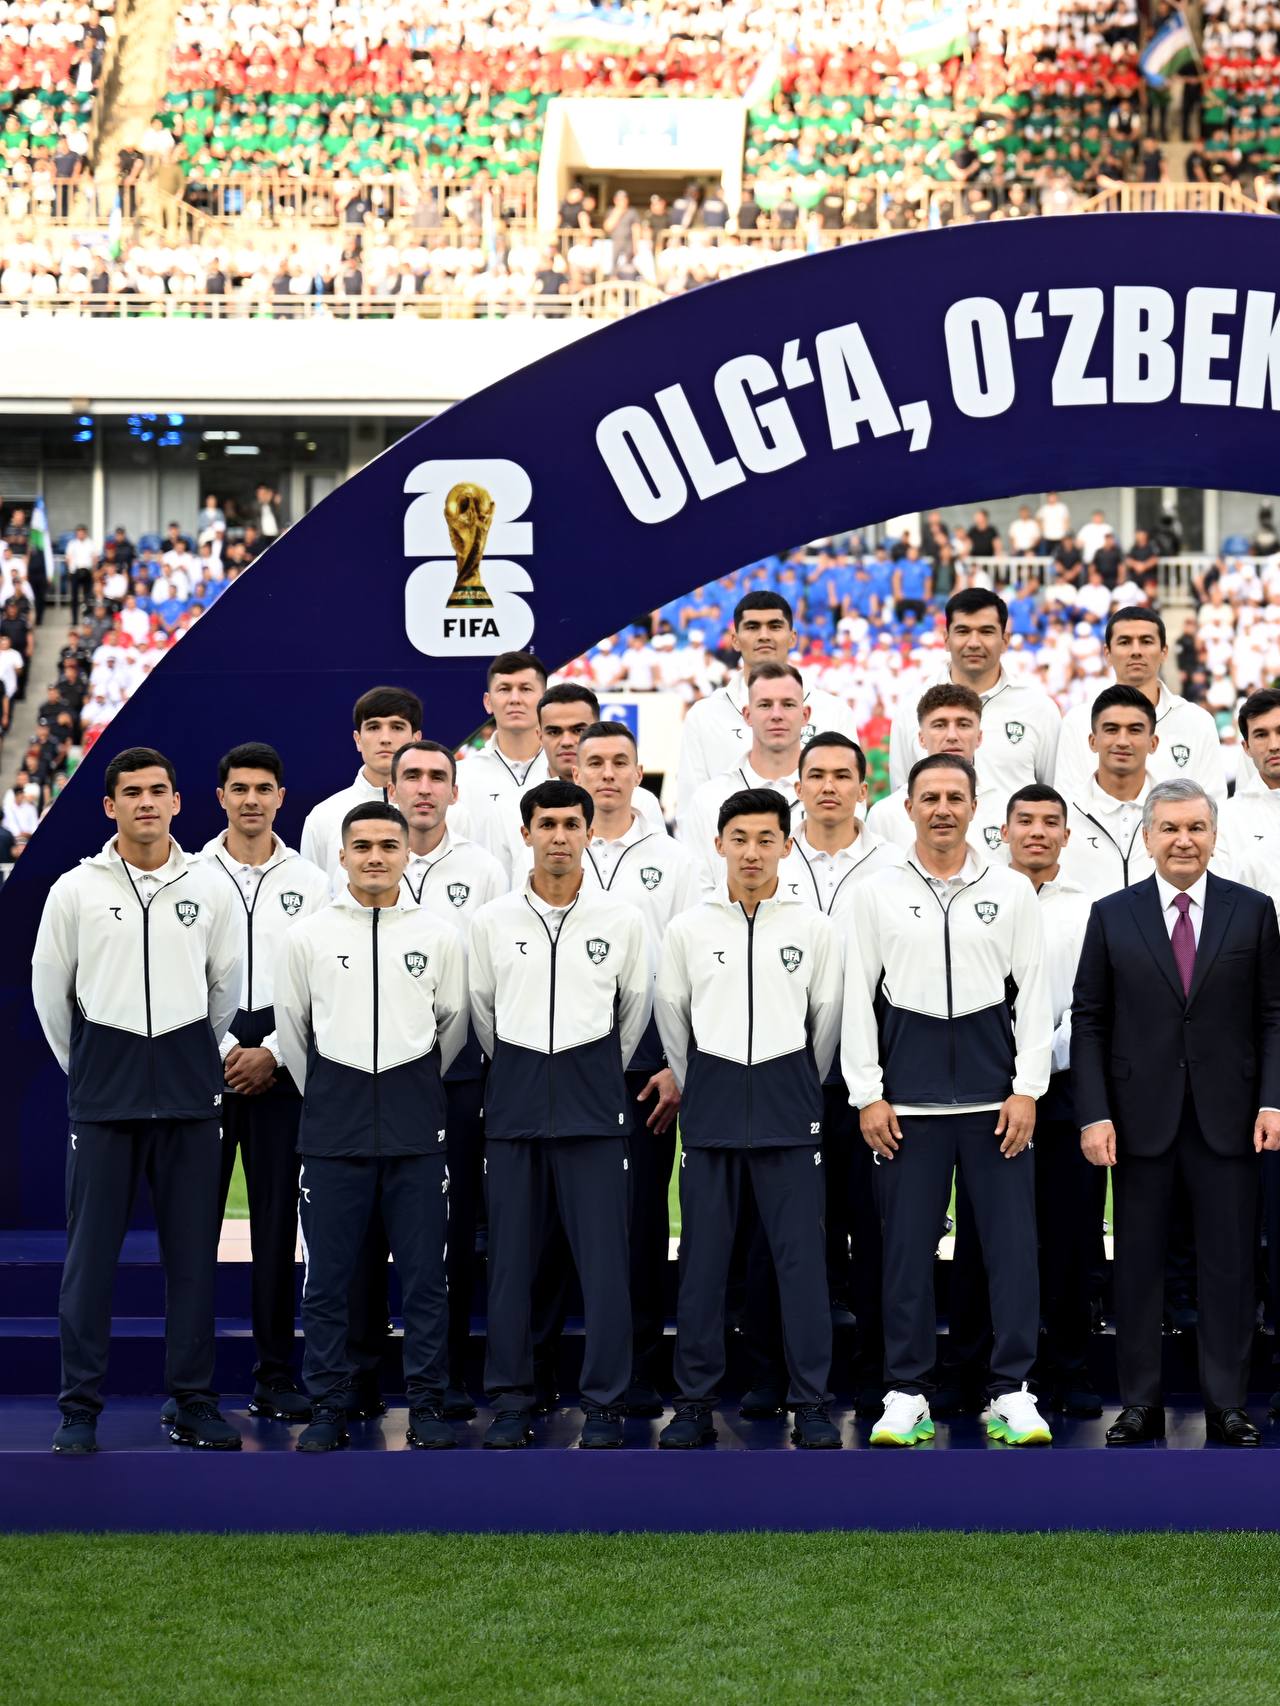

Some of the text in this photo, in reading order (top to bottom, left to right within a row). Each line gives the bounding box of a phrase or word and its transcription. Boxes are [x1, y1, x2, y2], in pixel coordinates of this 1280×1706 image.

[443, 618, 500, 638] FIFA
[642, 868, 660, 882] UFA
[449, 885, 467, 898] UFA
[283, 893, 301, 906] UFA
[178, 903, 196, 917] UFA
[977, 903, 996, 915] UFA
[589, 941, 606, 955] UFA
[407, 954, 425, 968] UFA
[782, 949, 800, 963] UFA
[618, 1112, 624, 1125] 8
[810, 1122, 820, 1134] 22
[623, 1158, 628, 1170] 8
